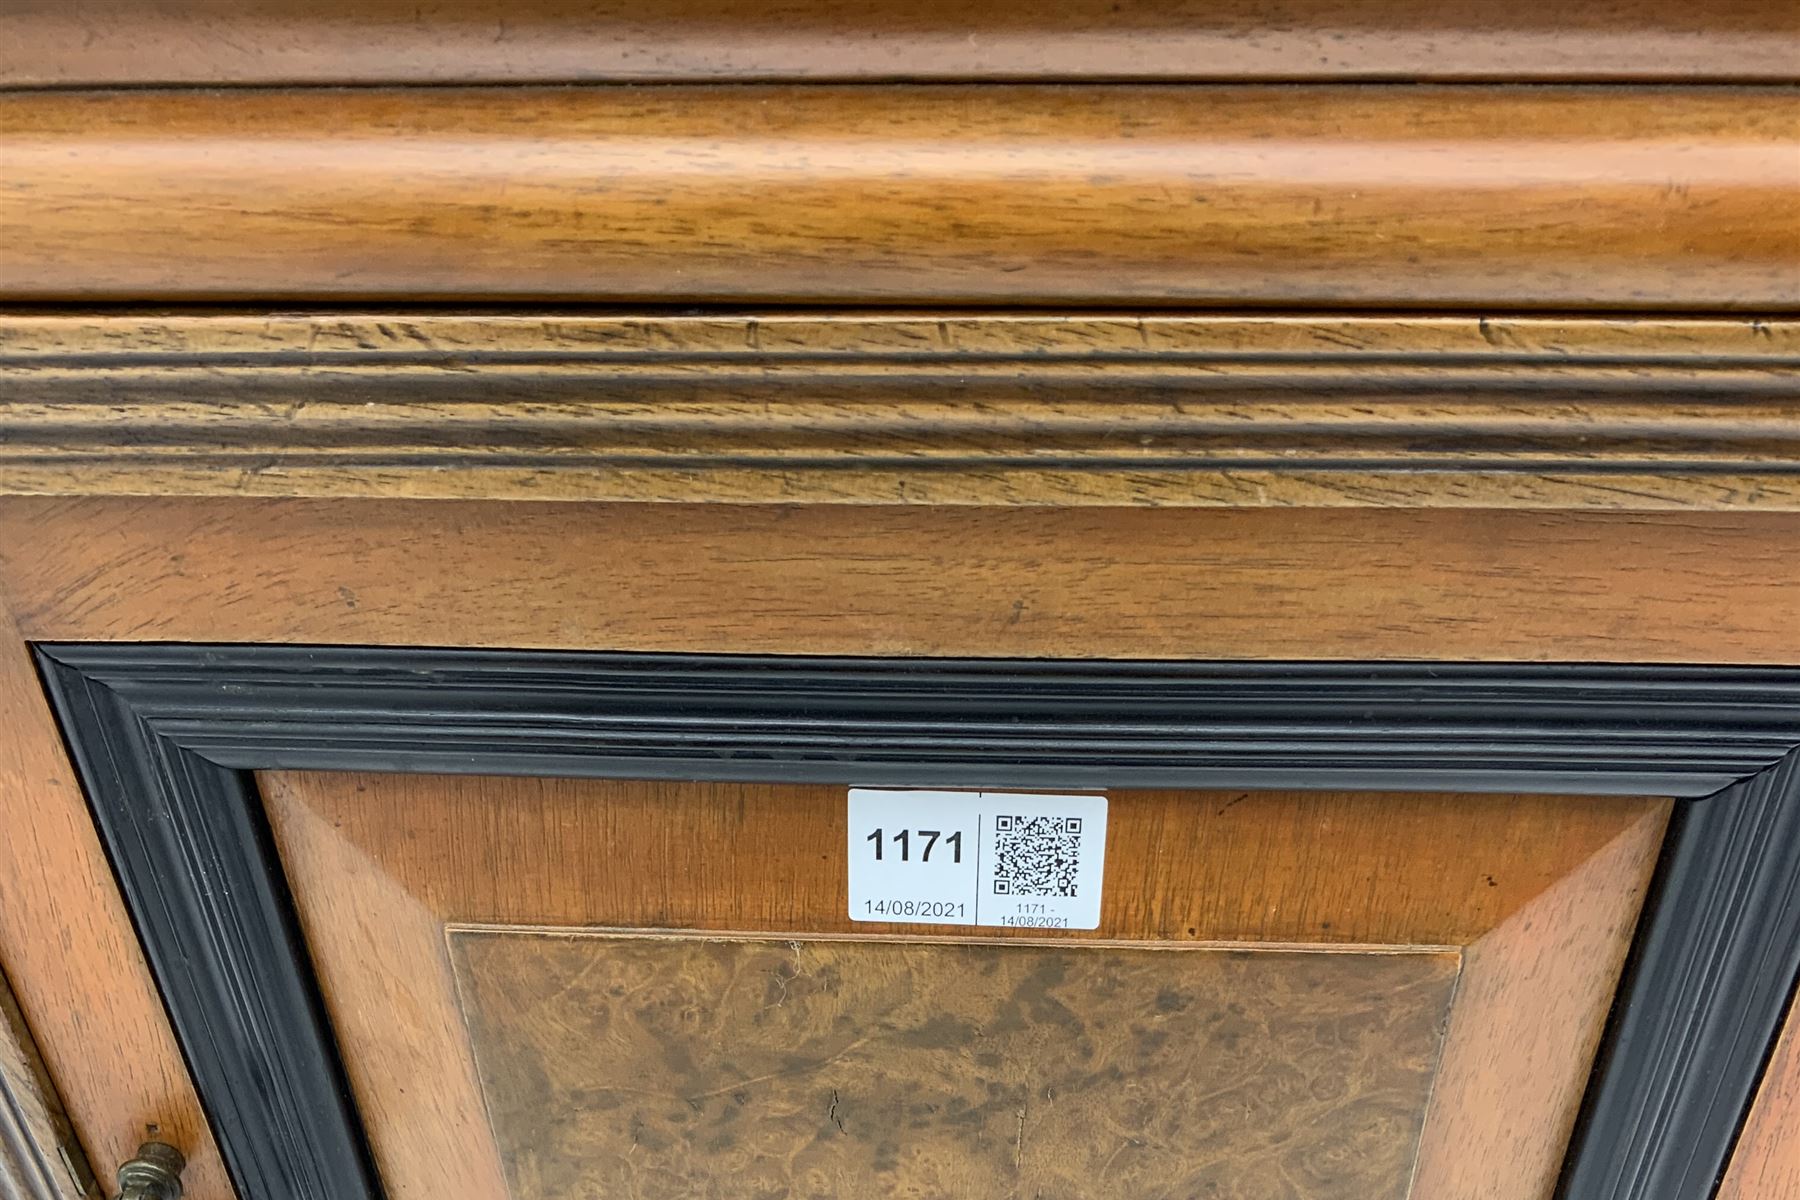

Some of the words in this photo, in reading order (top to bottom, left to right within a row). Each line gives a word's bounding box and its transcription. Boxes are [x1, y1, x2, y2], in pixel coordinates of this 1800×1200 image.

[867, 828, 962, 864] 1171
[864, 899, 965, 918] 14/08/2021
[1017, 903, 1045, 914] 1171
[1001, 915, 1068, 928] 14/08/2021
